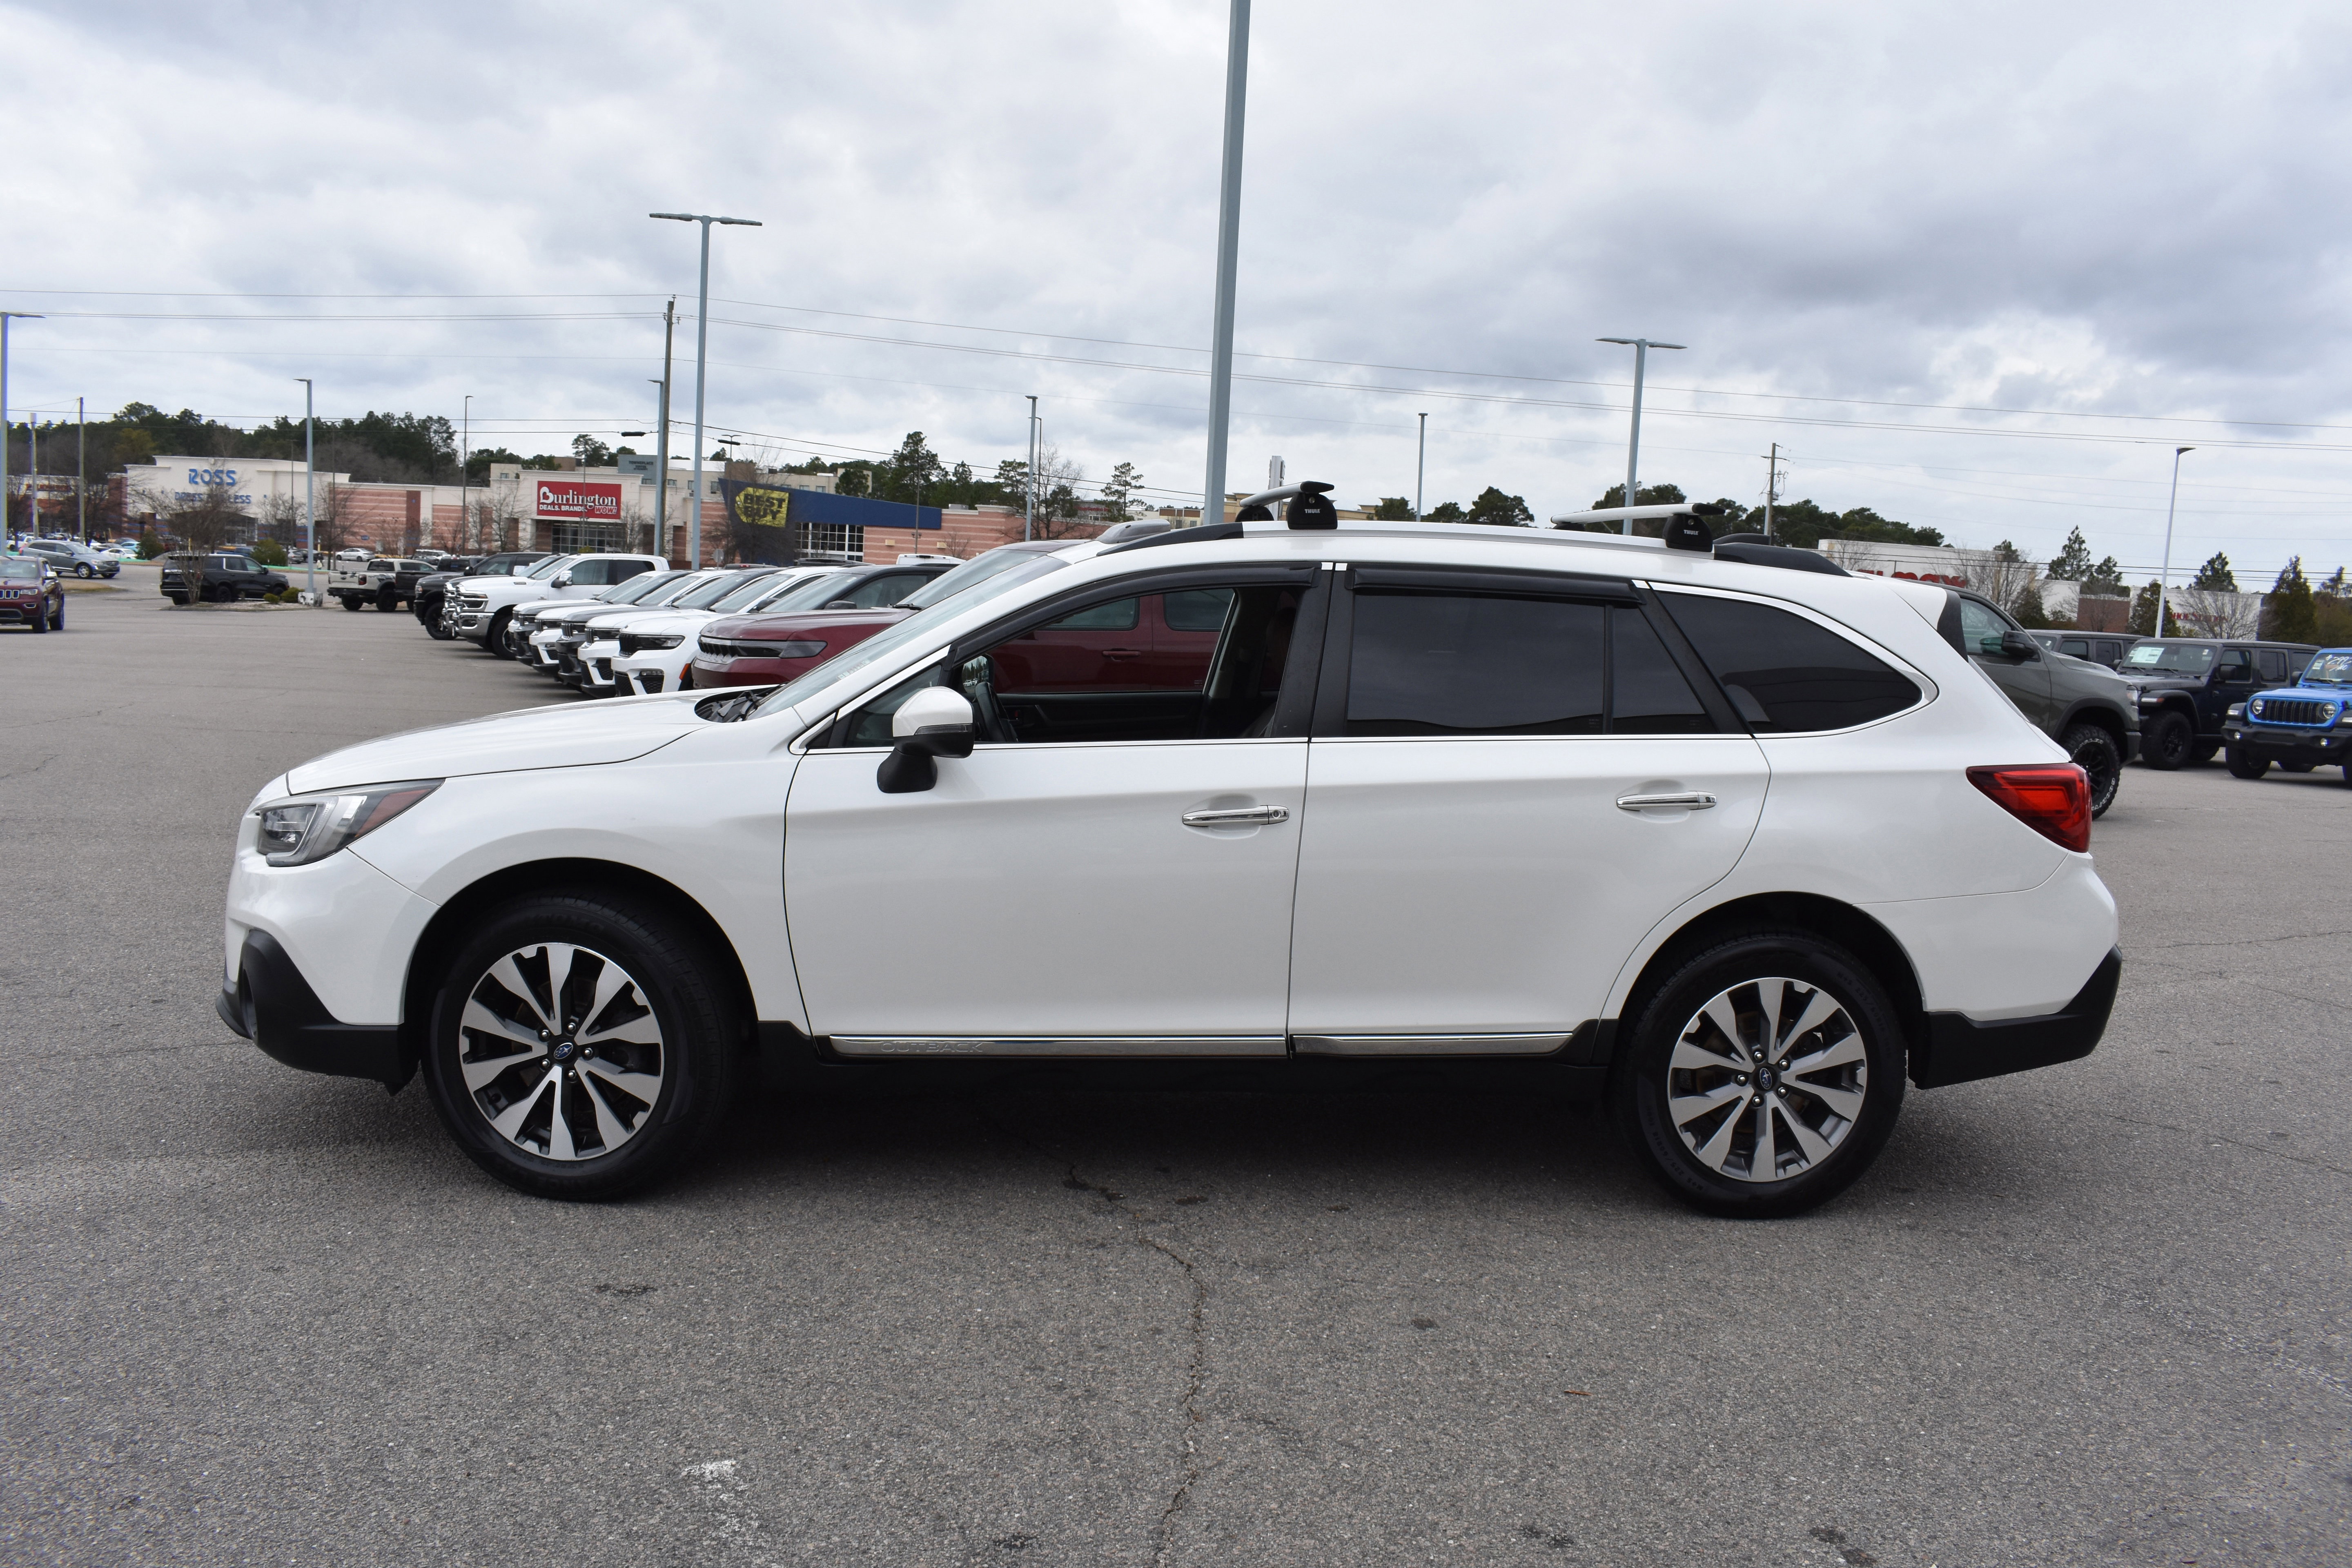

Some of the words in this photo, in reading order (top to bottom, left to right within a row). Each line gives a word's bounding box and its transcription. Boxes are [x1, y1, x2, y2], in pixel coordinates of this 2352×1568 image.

[189, 468, 236, 486] ROSS
[540, 486, 616, 509] Burlington
[744, 493, 786, 509] BEST
[595, 506, 617, 514] WOW!
[743, 506, 781, 520] BUY
